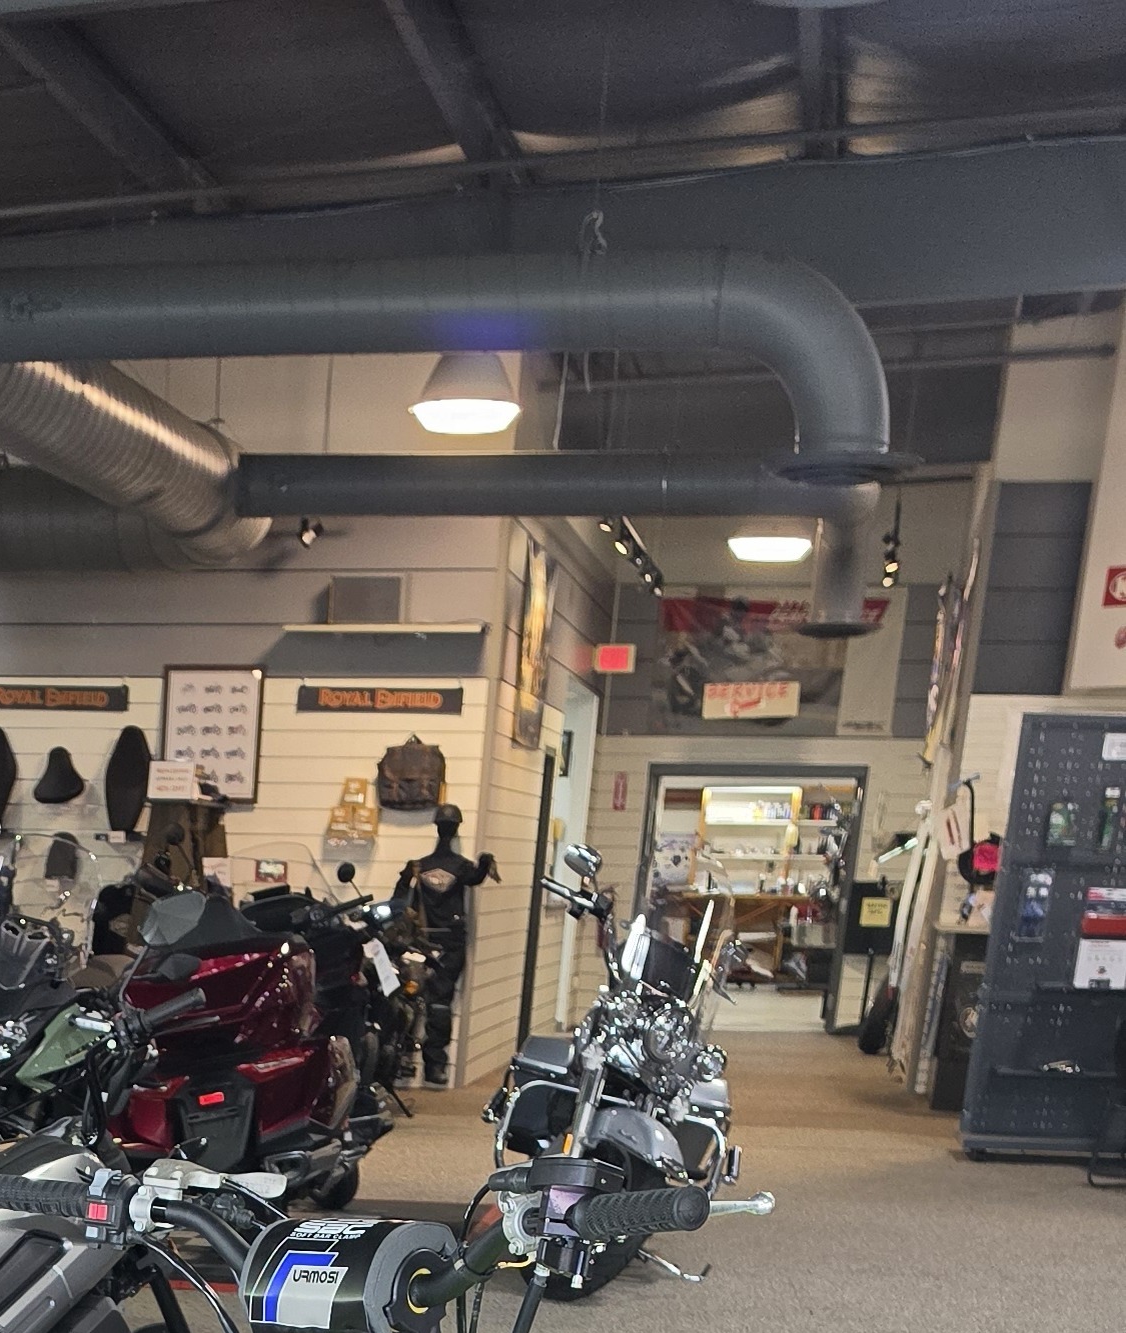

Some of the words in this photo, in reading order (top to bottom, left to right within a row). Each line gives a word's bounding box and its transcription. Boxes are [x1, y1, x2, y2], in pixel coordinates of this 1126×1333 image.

[44, 688, 109, 708] ENFIELD
[317, 687, 373, 708] ROYAL
[375, 688, 444, 710] ENFIELD
